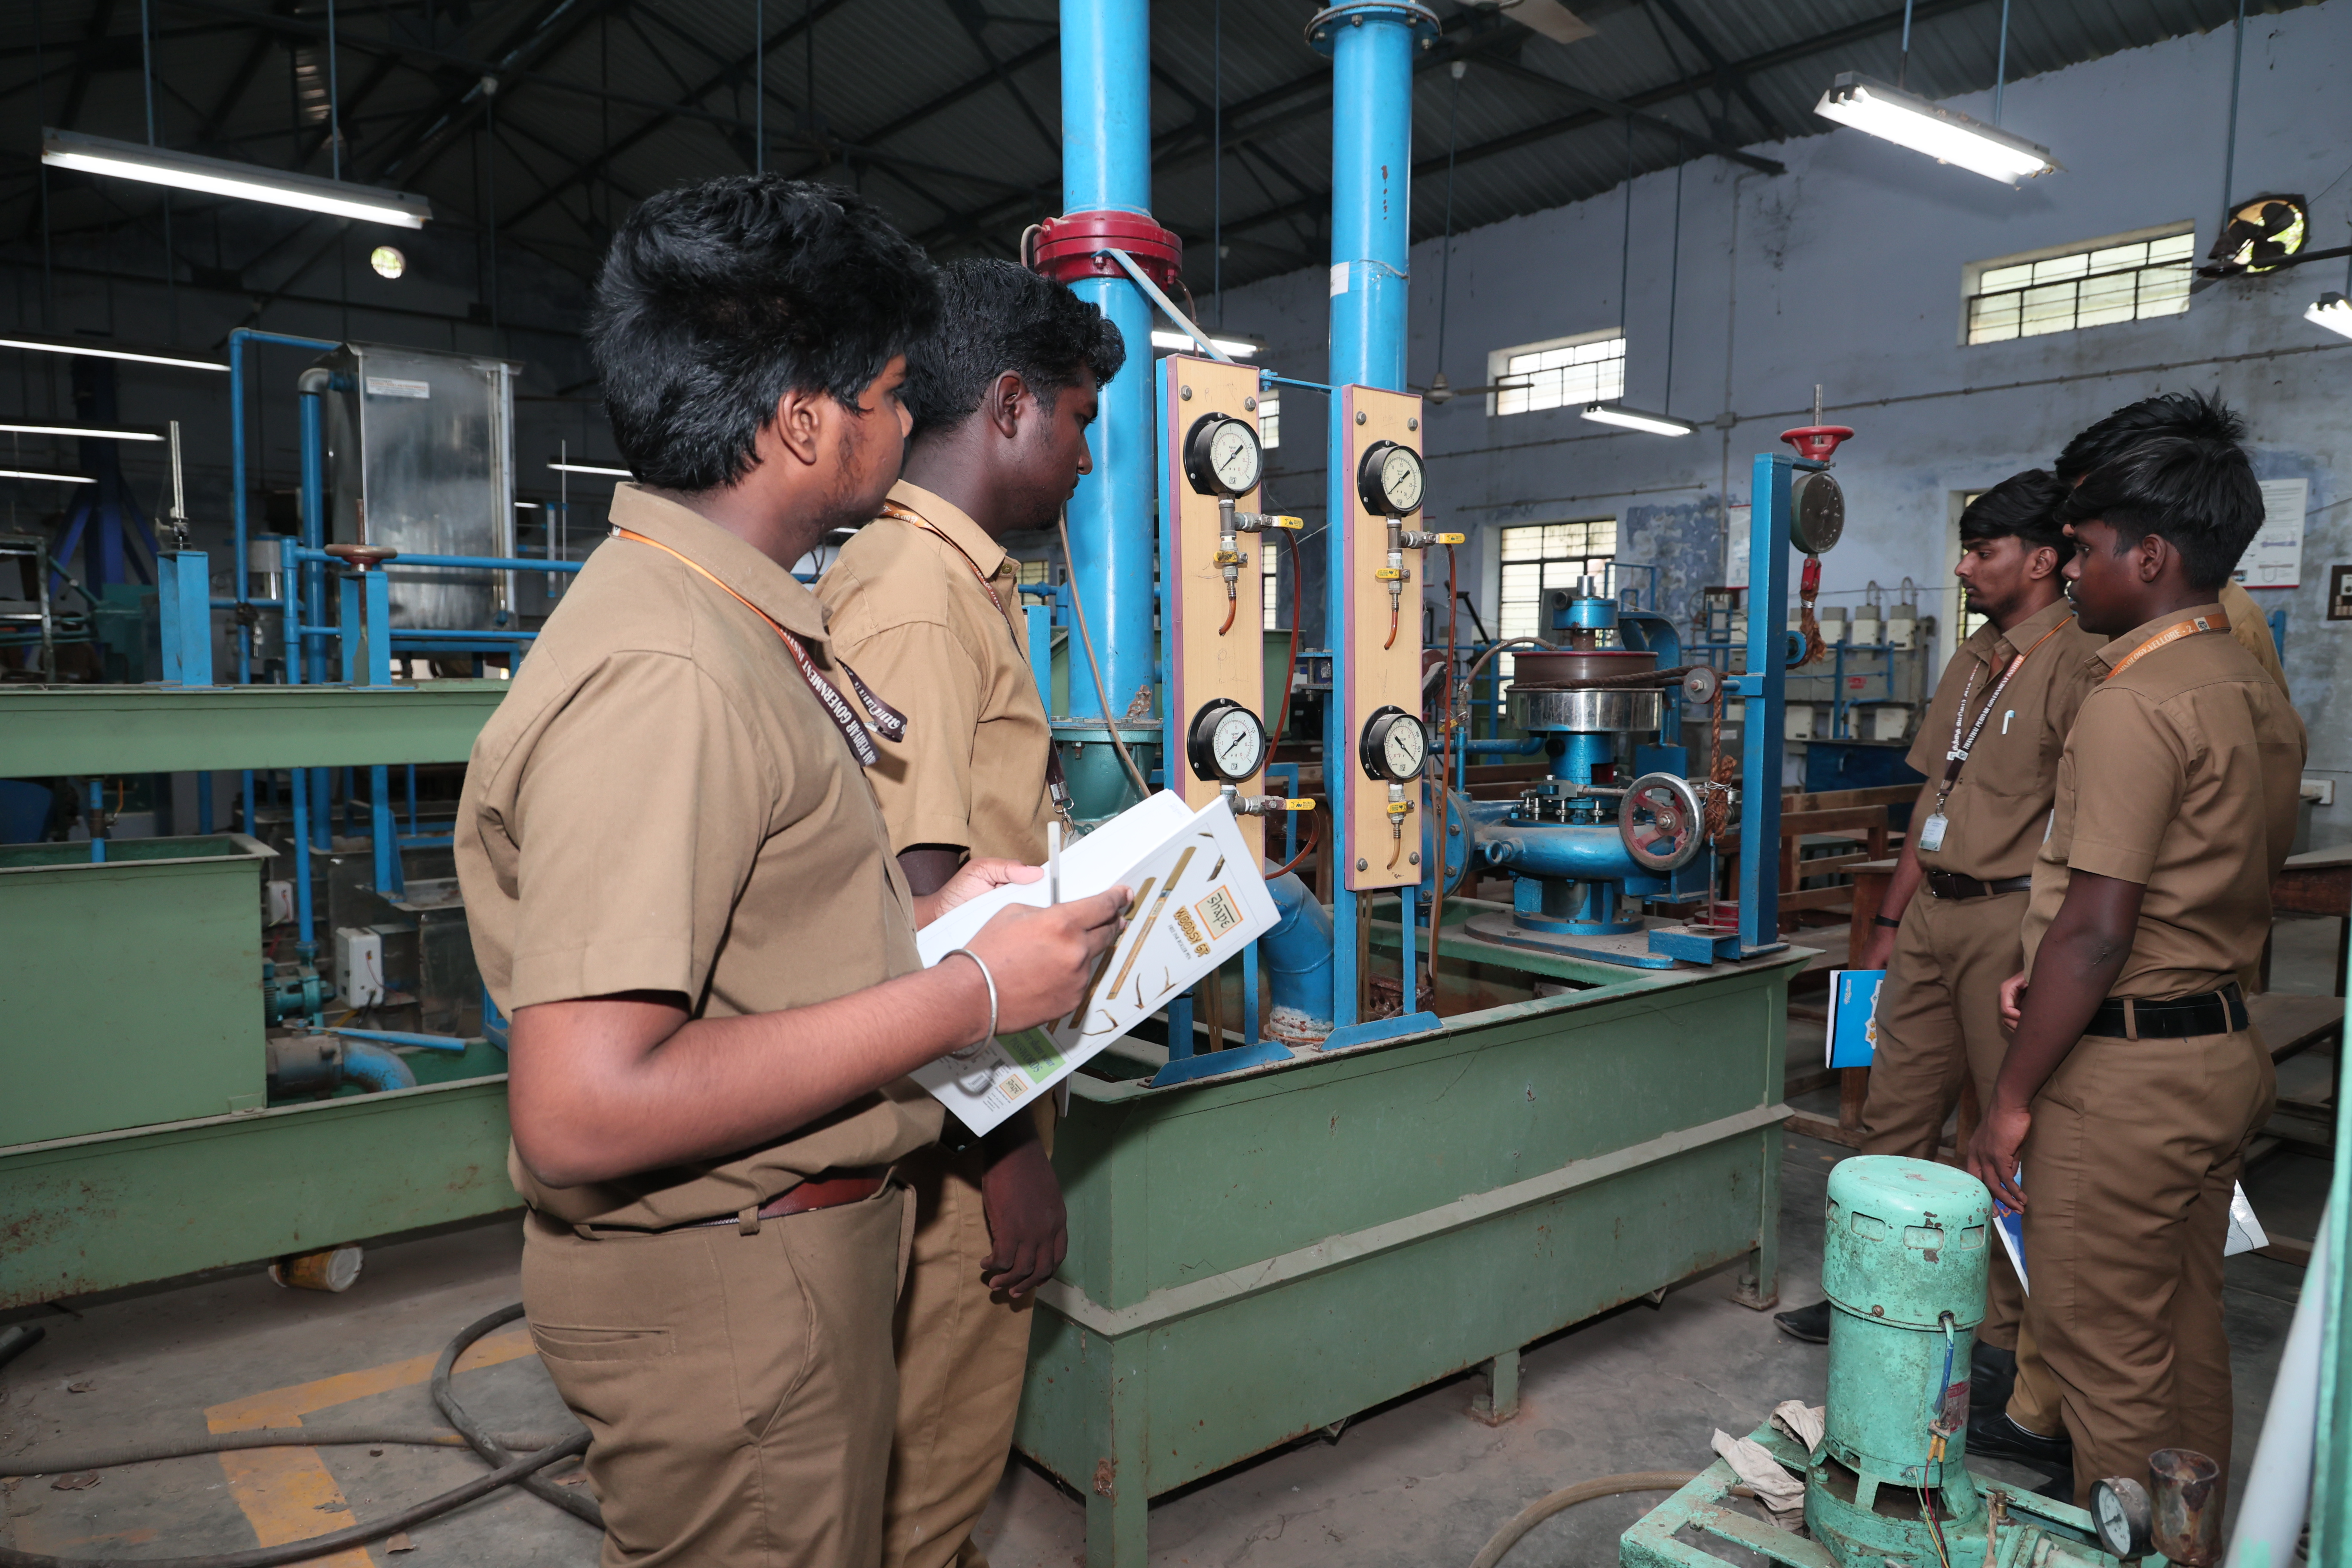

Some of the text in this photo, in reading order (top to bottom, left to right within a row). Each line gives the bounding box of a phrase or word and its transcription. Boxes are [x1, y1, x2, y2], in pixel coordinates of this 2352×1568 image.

[801, 660, 853, 724] GOVERNMENT
[1975, 707, 1991, 730] PERIYAR
[1987, 677, 2010, 707] GOVERNMENT
[845, 720, 871, 756] PERIYAR
[1207, 892, 1235, 928] shape
[1168, 924, 1176, 933] FREE
[1177, 939, 1188, 953] ROLLER
[1173, 905, 1211, 957] WOODSY GT
[1008, 1036, 1044, 1073] PASSWORDS
[1042, 1053, 1056, 1067] your
